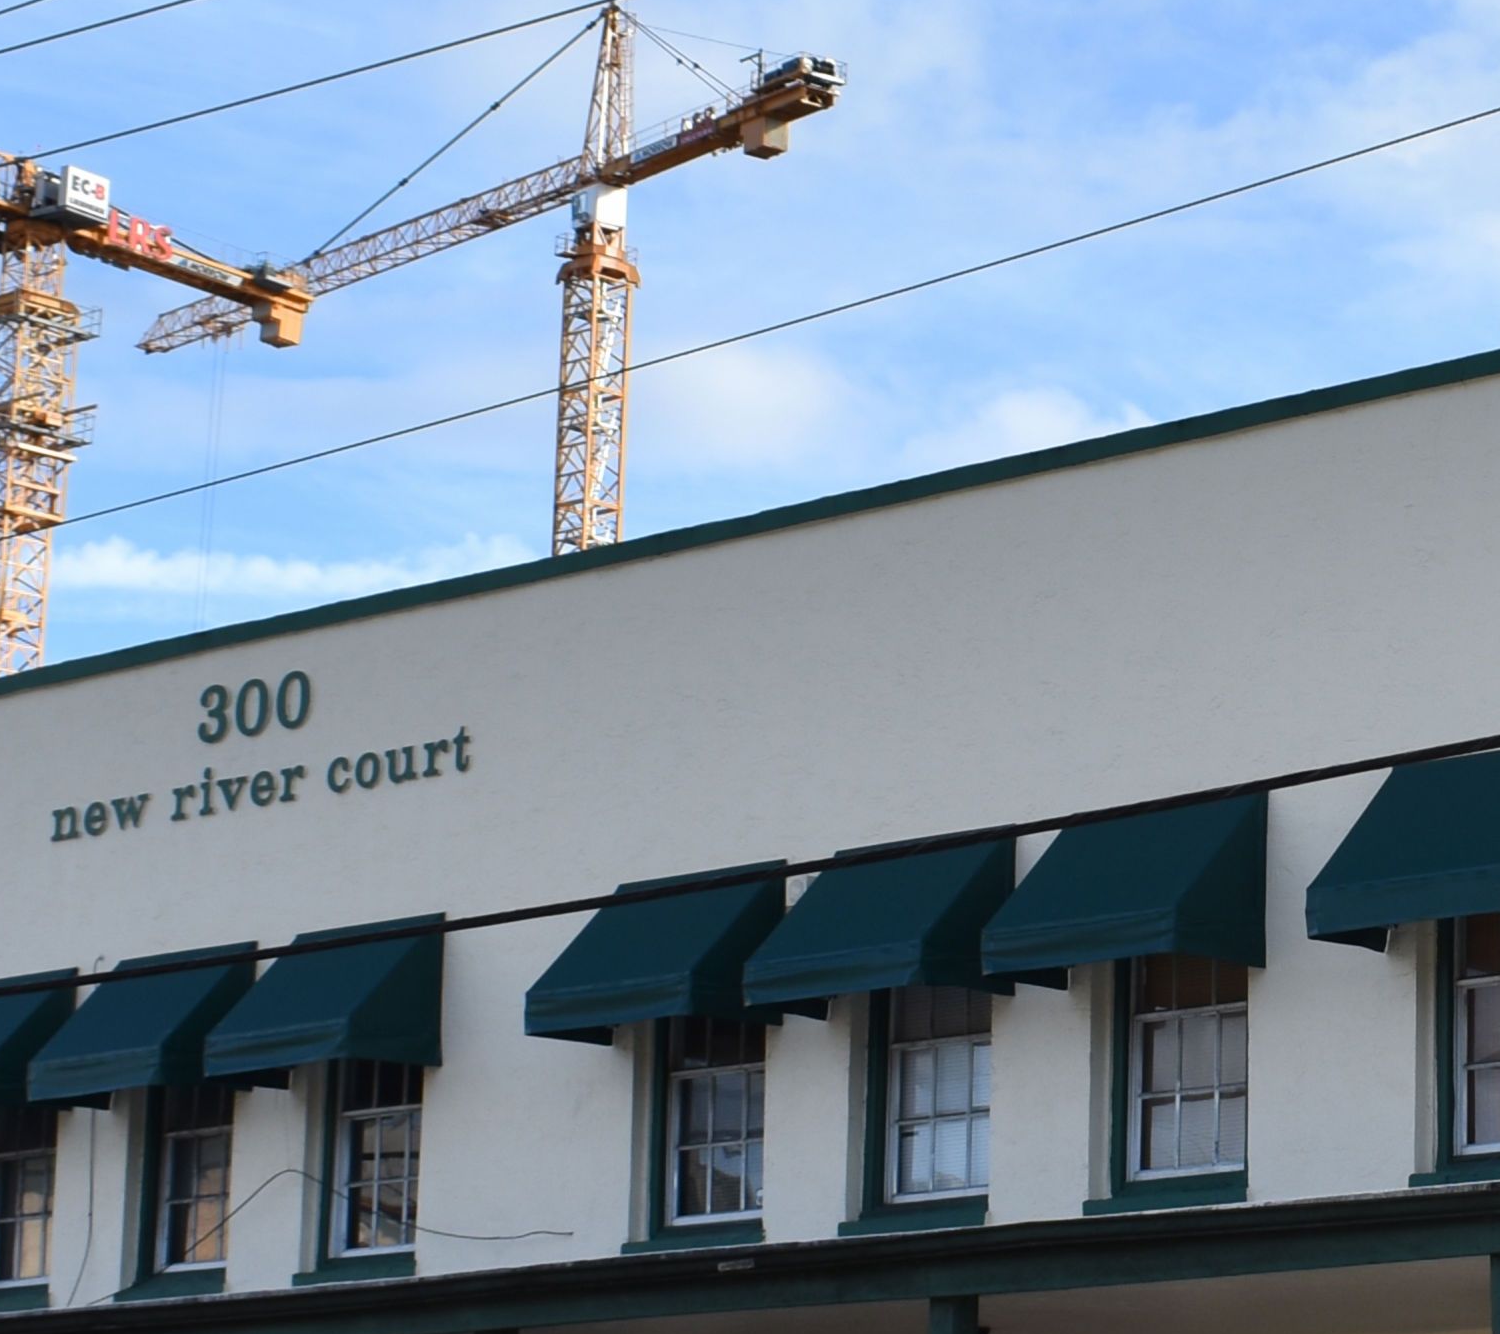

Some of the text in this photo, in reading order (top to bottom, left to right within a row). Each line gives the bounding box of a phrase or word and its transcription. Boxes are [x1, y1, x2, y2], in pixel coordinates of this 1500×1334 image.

[71, 175, 106, 201] EC-B
[108, 208, 174, 261] LRS
[197, 670, 311, 744] 300
[50, 725, 473, 843] new river court
